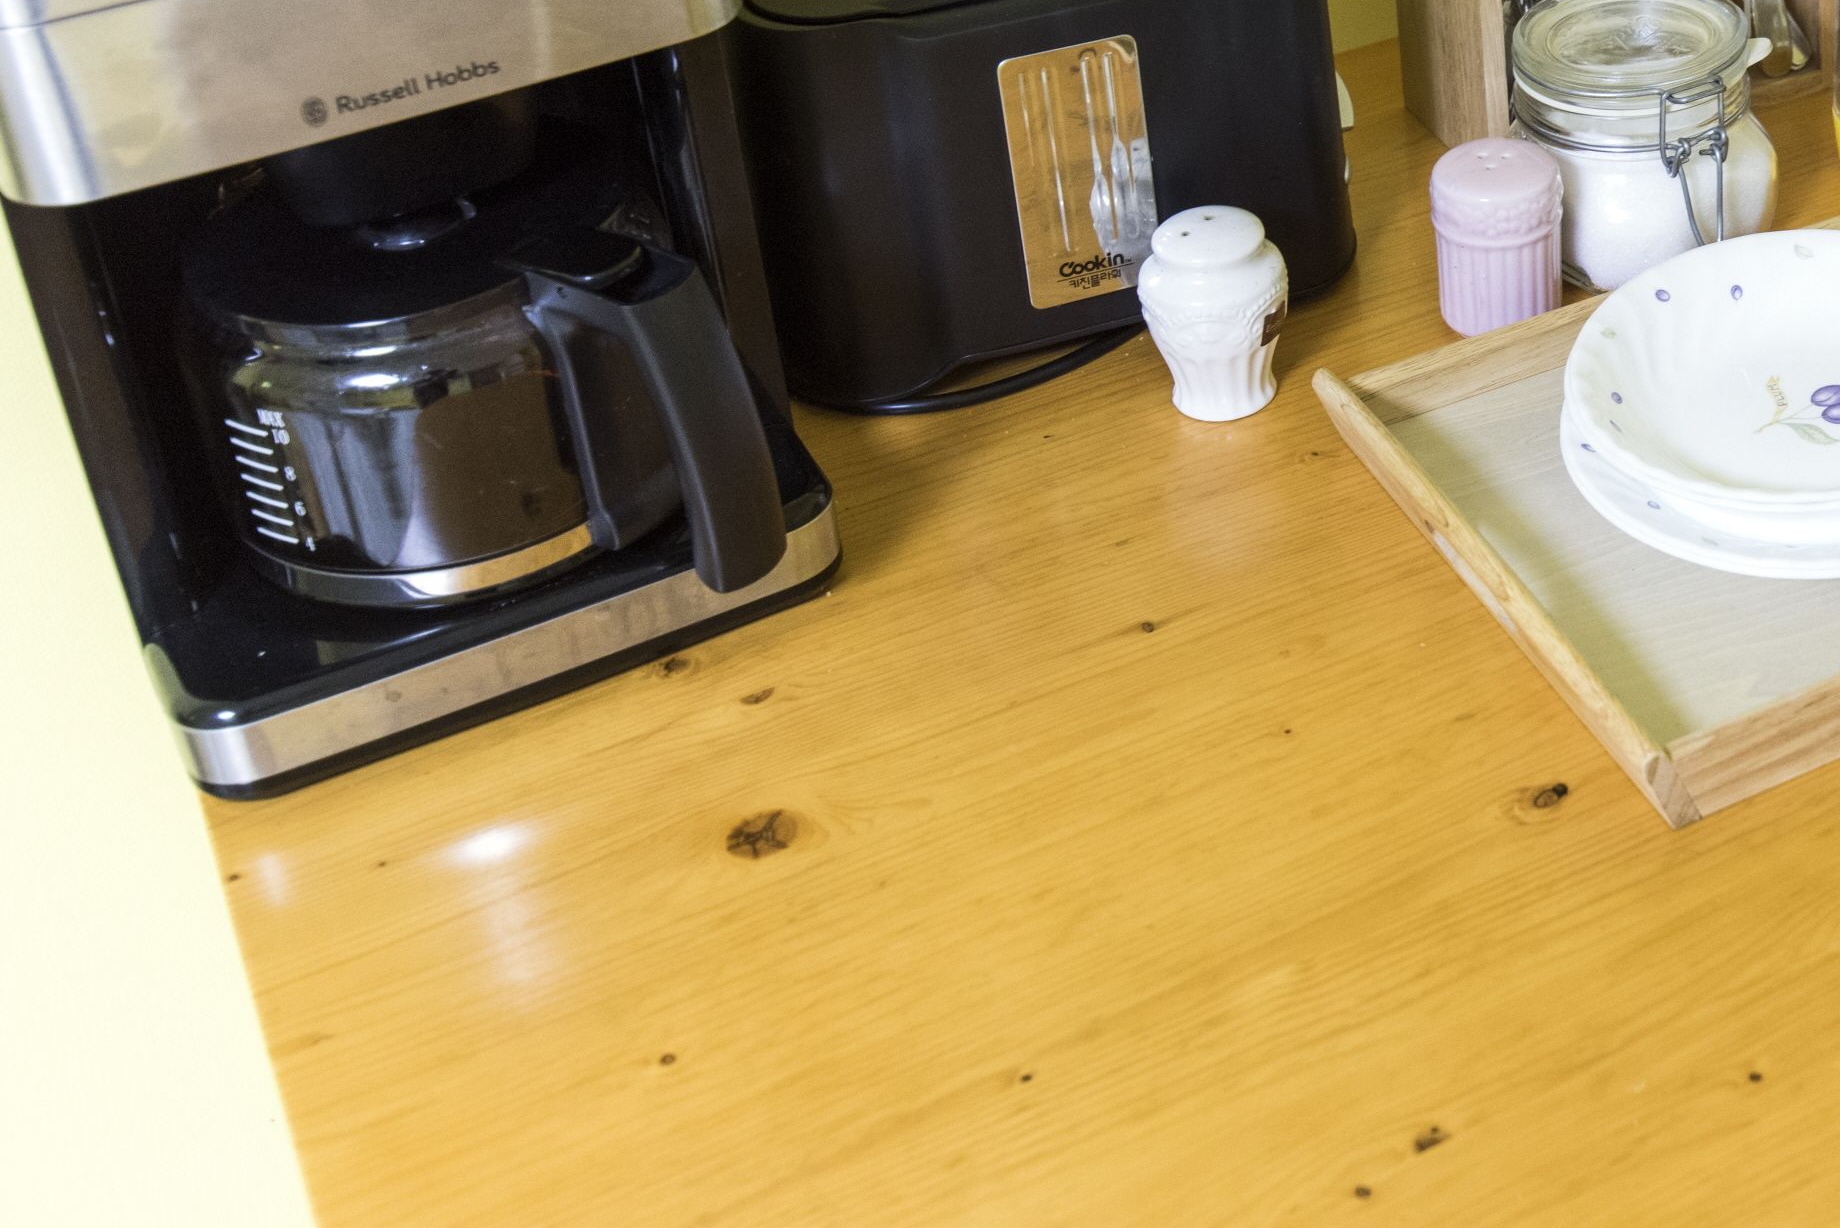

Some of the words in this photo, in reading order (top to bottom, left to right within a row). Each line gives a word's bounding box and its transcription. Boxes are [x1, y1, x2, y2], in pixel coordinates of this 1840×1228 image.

[335, 76, 421, 114] Russell
[424, 60, 500, 91] Hobbs
[1059, 252, 1124, 277] Cookin
[294, 501, 307, 517] 6
